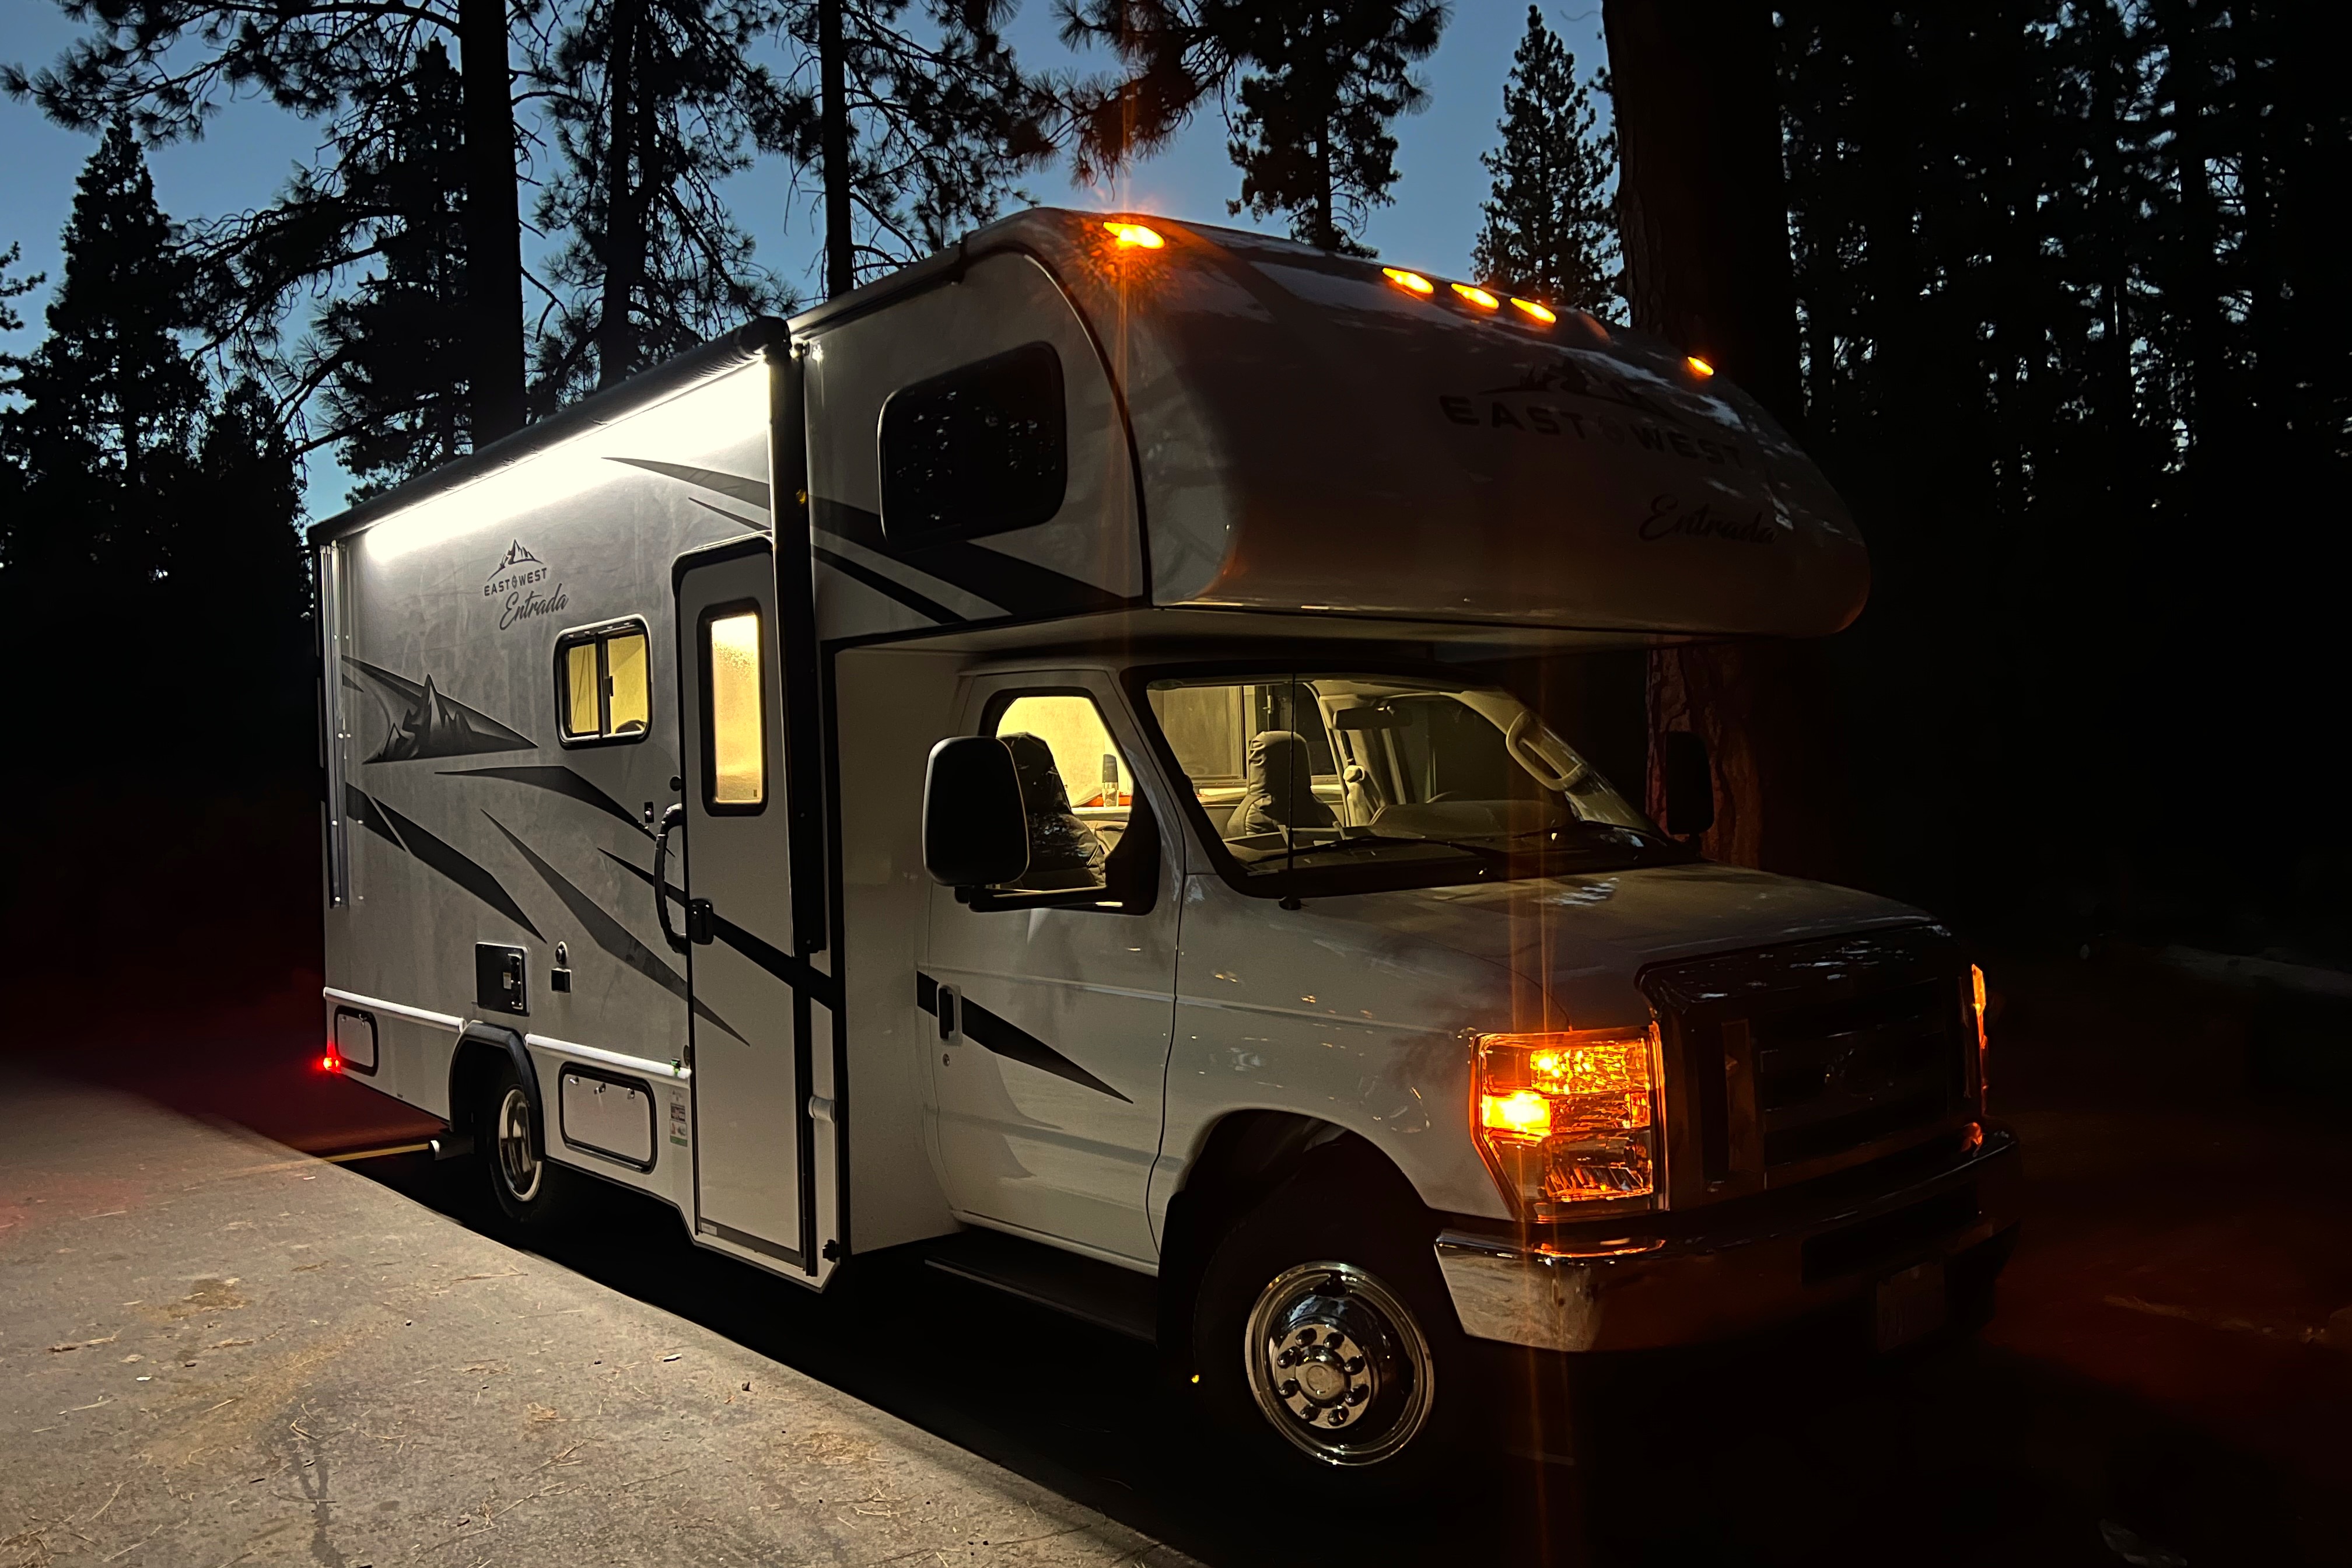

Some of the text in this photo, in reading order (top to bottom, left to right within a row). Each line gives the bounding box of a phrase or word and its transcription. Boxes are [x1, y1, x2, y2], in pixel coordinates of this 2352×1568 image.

[1439, 396, 1744, 468] EAST WEST
[1639, 494, 1780, 543] Entrada
[484, 568, 547, 596] EAST WEST
[499, 583, 569, 631] Entrada
